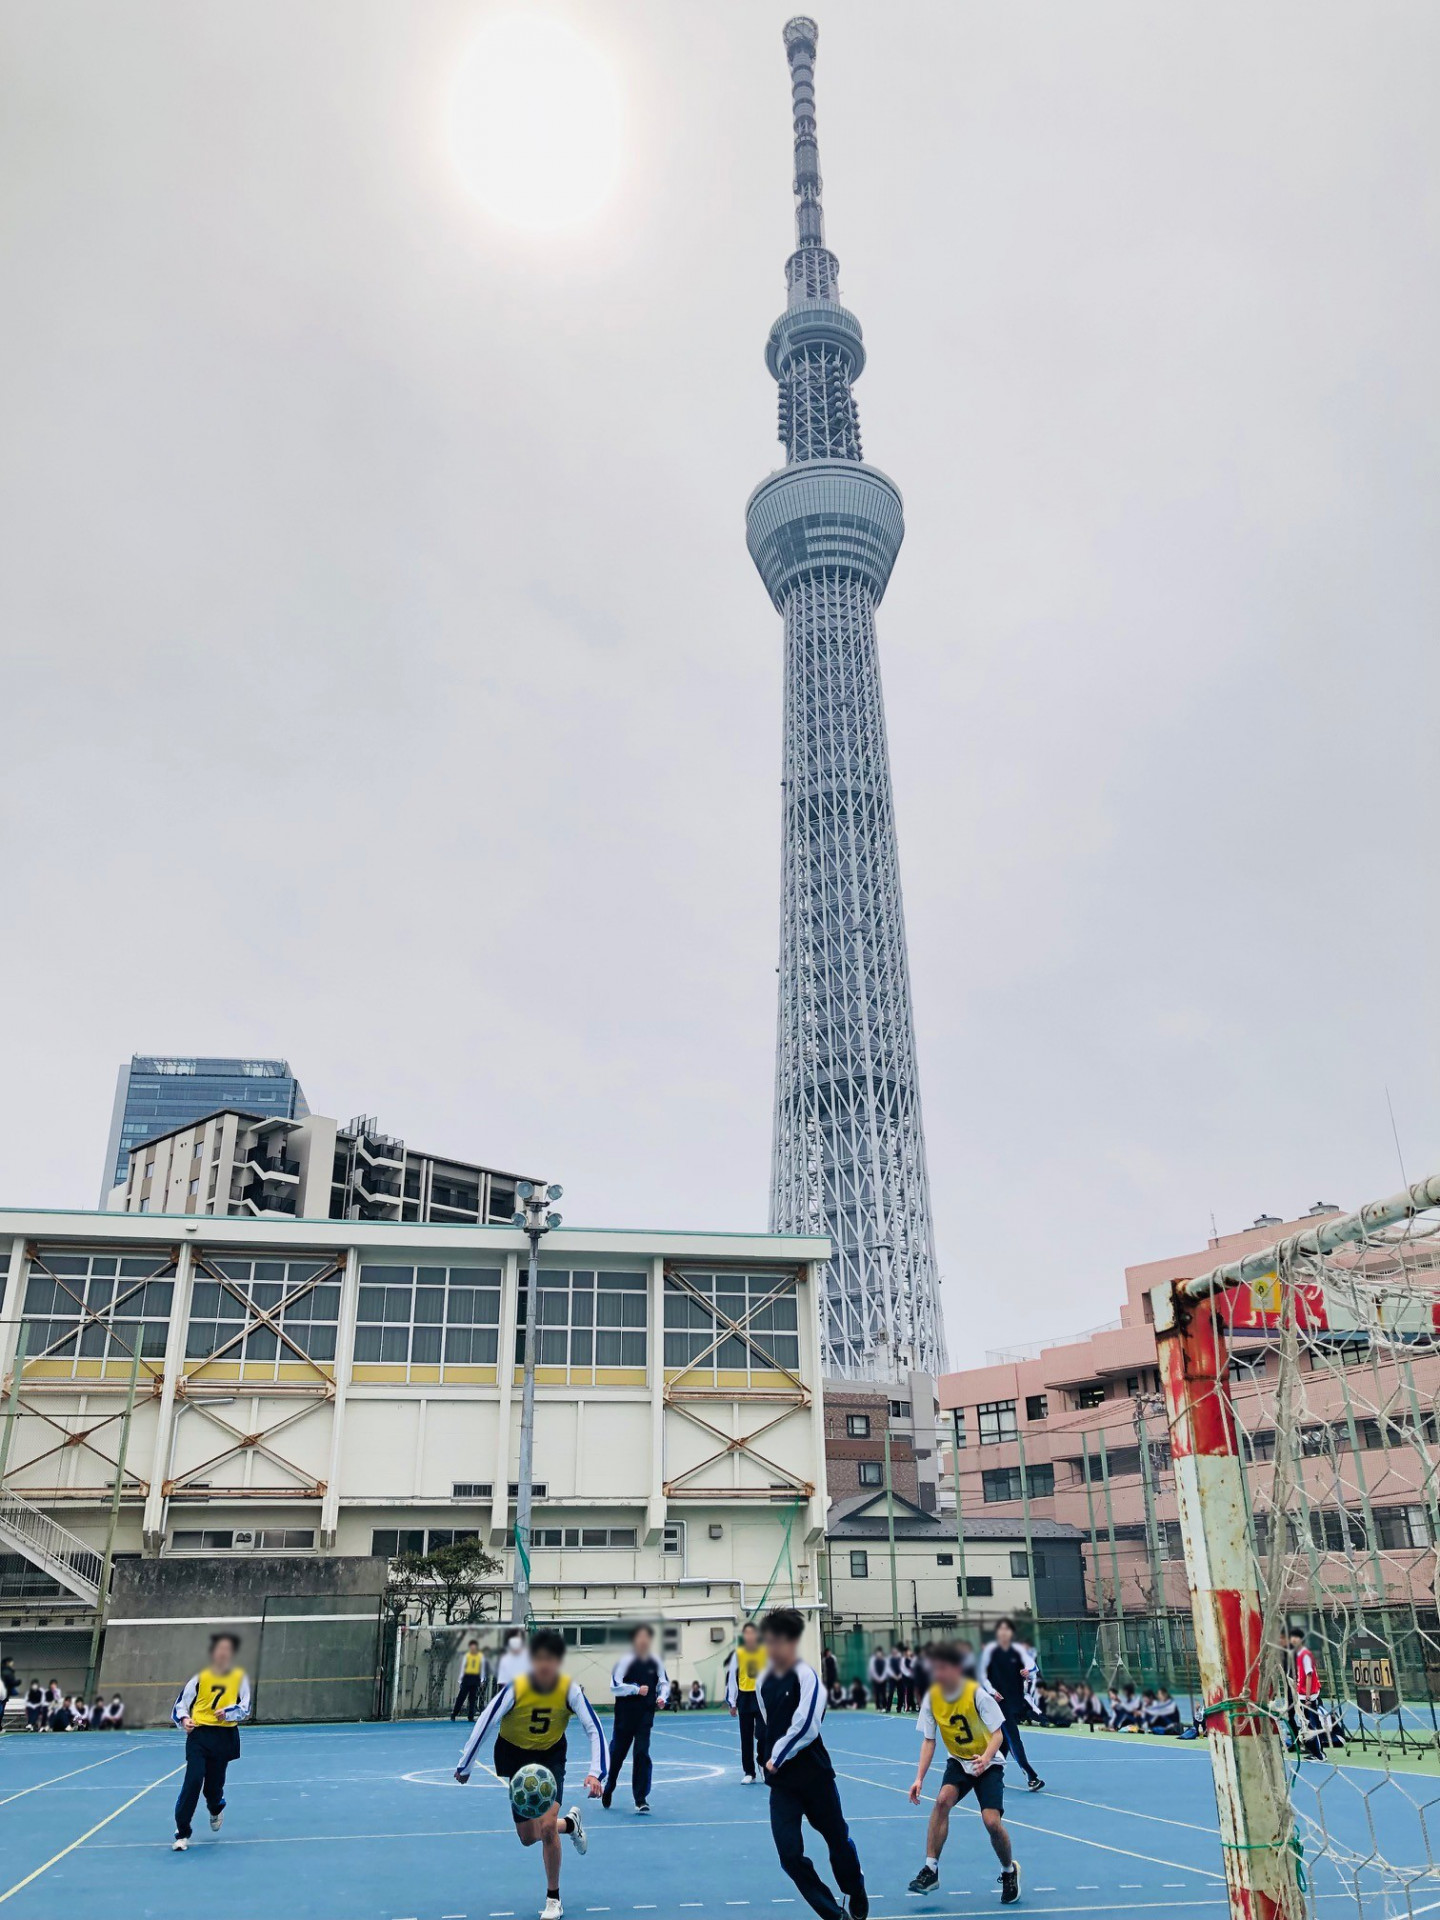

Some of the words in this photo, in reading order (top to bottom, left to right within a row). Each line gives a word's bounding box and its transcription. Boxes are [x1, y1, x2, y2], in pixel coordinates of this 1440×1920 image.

[211, 1685, 226, 1710] 7
[529, 1708, 552, 1734] 5
[950, 1714, 973, 1744] 3
